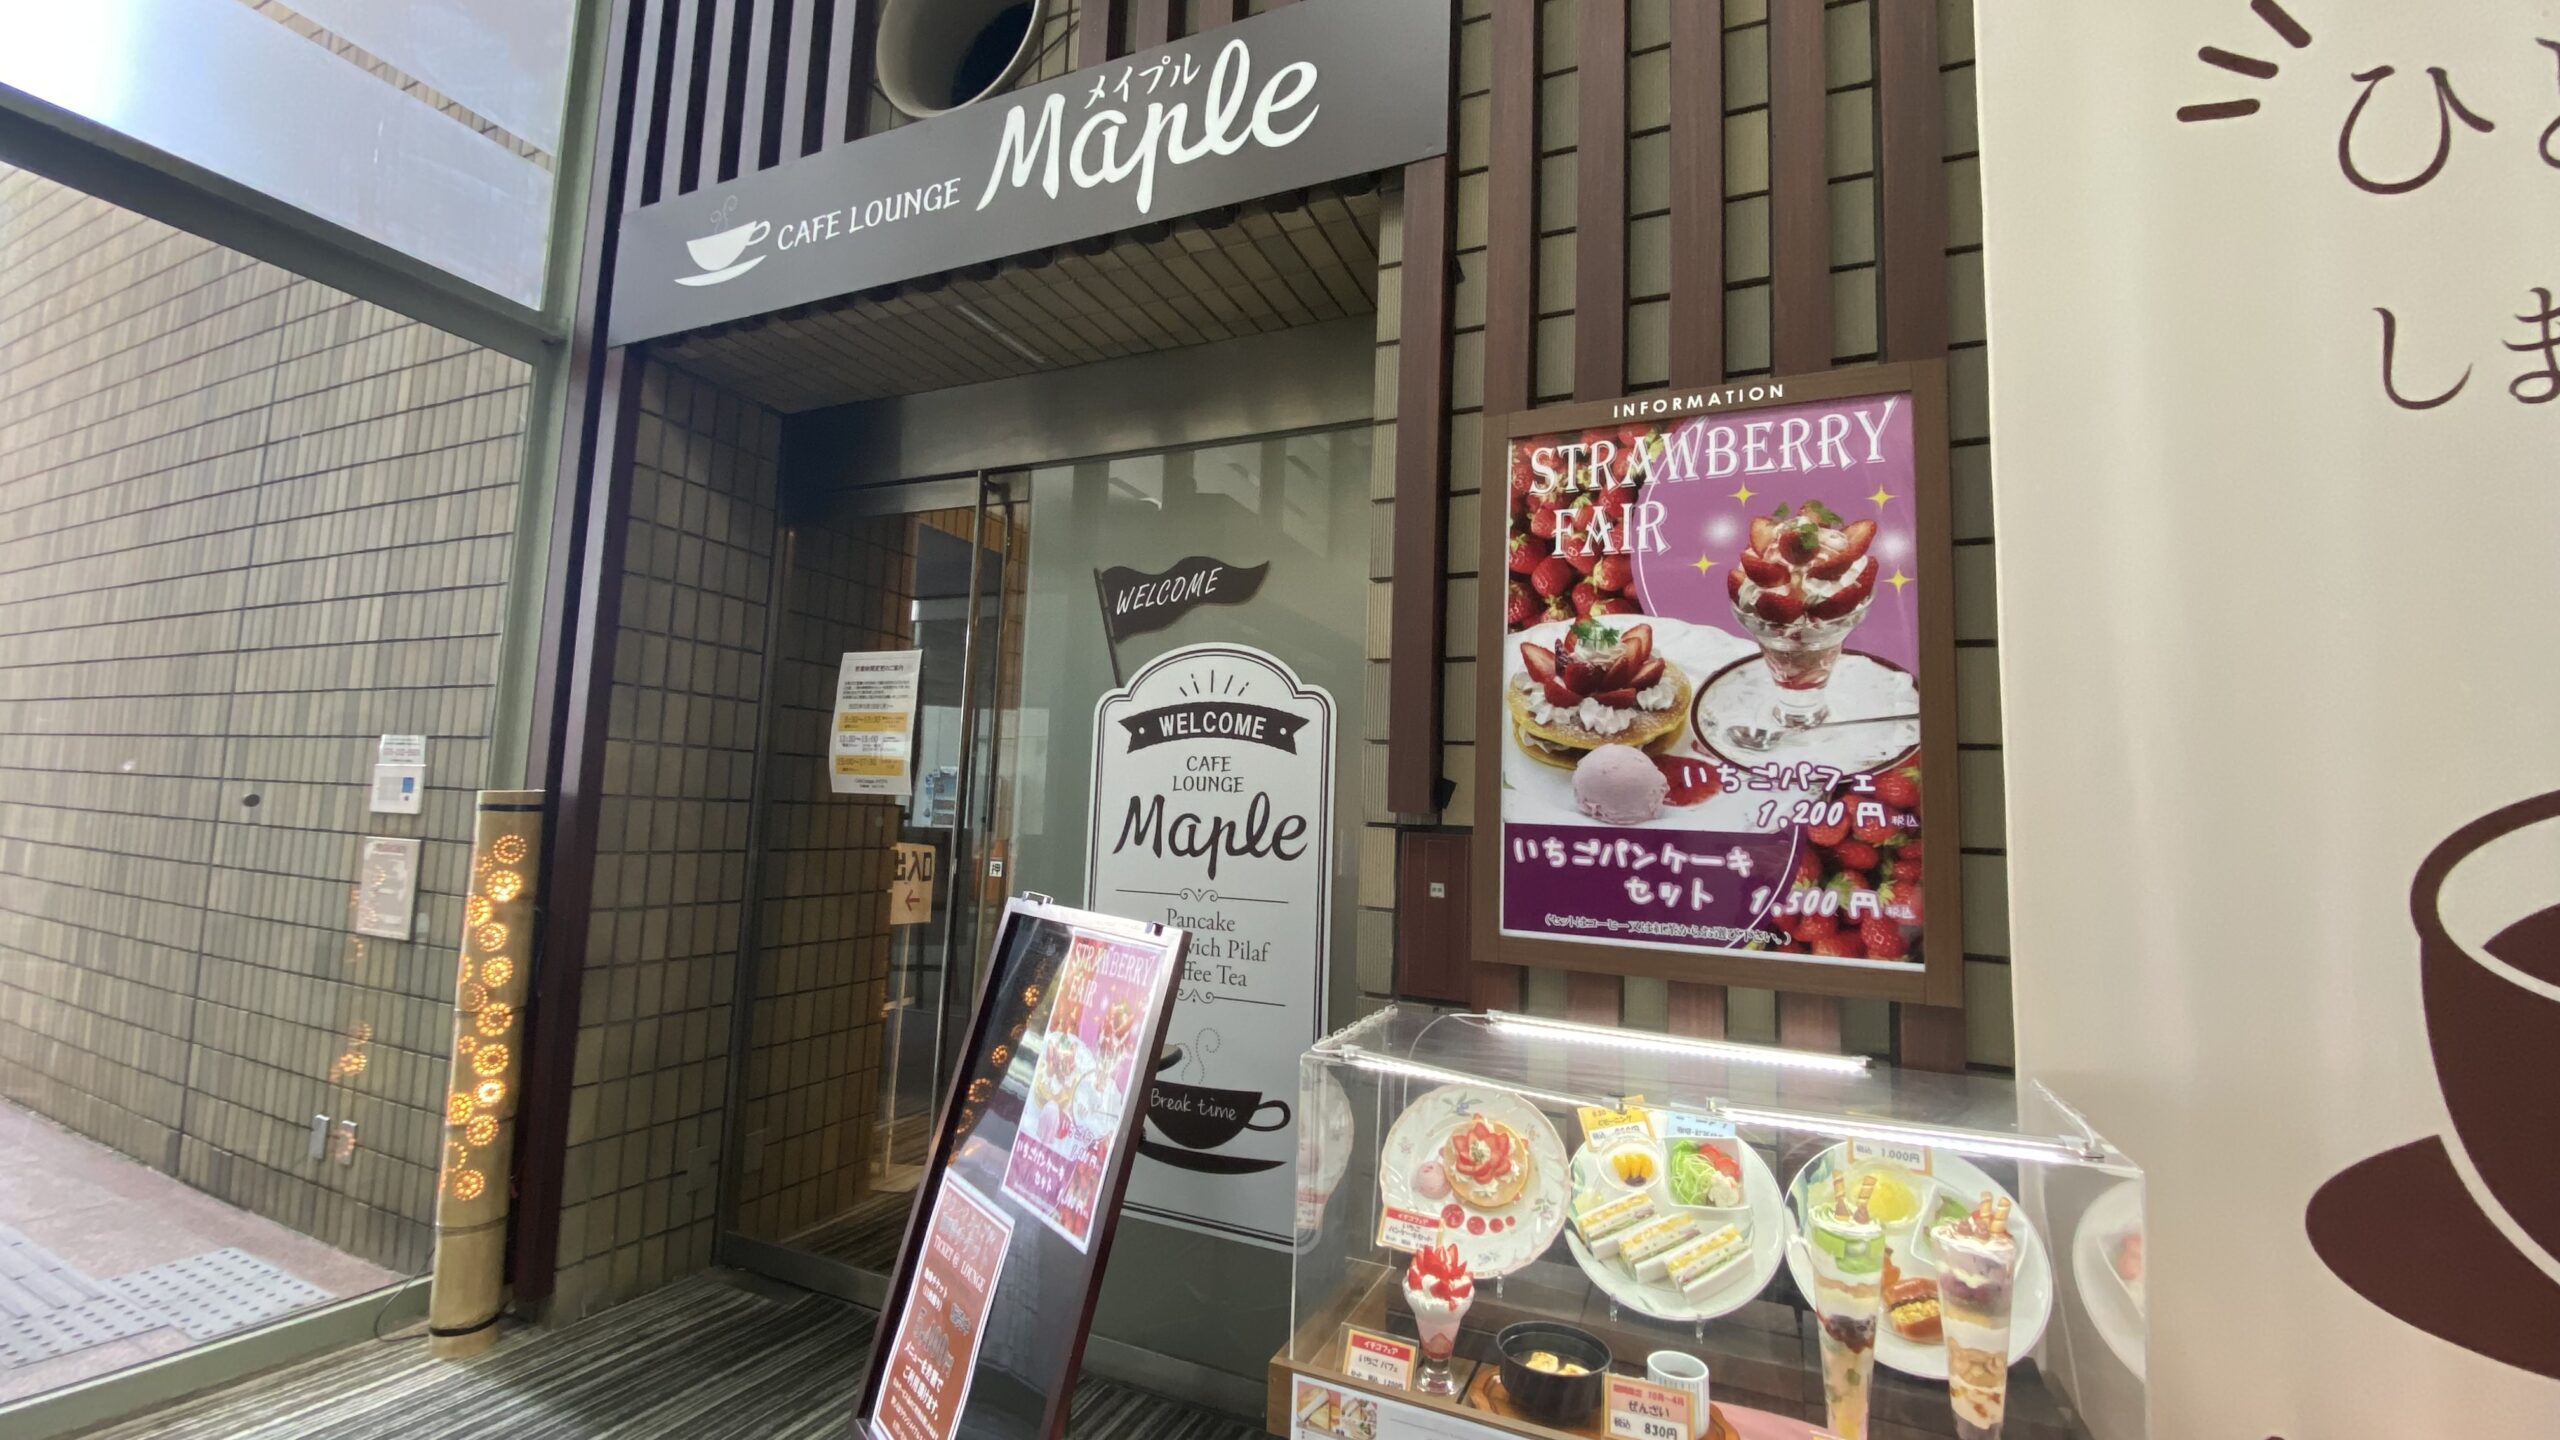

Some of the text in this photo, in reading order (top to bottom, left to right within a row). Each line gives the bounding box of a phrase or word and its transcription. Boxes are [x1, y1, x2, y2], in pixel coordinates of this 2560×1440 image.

[1086, 53, 1201, 109] メイプル
[777, 38, 1320, 250] CAFE LOUNGE Maple
[1612, 384, 1784, 419] INFORMATION
[1529, 394, 1899, 496] STRAWBERRY
[1551, 499, 1671, 558] FAIR
[1115, 567, 1224, 616] WELCOME
[1158, 711, 1267, 740] WELCOME
[1186, 755, 1231, 773] CAFE
[1680, 762, 1877, 794] いちごパフェ
[1172, 775, 1245, 793] LOUNGE
[1112, 791, 1309, 880] Maple
[1512, 837, 1755, 879] いちごパンケーキ
[1623, 876, 1714, 912] セット
[1166, 907, 1236, 933] Pancake
[1071, 942, 1157, 987] STRAWBERRY
[1228, 939, 1271, 962] Pilaf
[1067, 975, 1098, 1009] FAIR
[1216, 964, 1248, 988] Tea
[1150, 1091, 1238, 1121] Break time
[1629, 1400, 1671, 1418] ぜんざい
[1644, 1422, 1678, 1440] 830円
